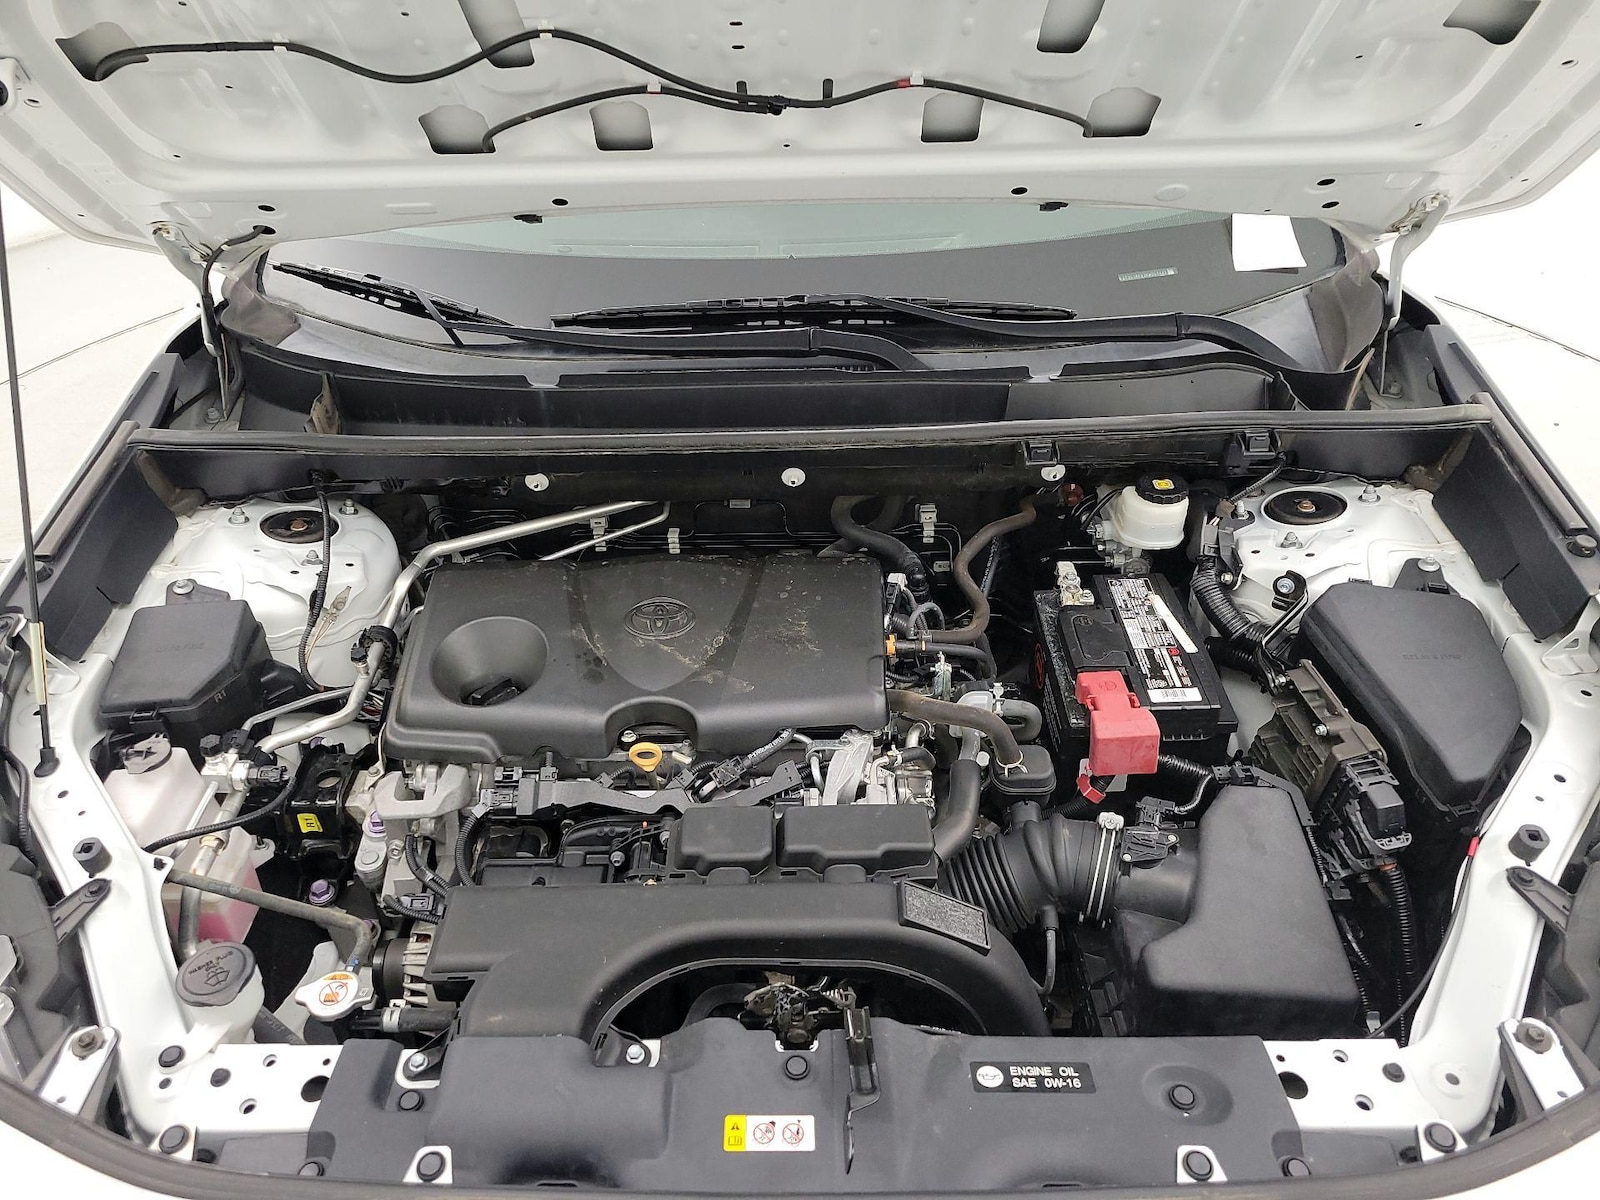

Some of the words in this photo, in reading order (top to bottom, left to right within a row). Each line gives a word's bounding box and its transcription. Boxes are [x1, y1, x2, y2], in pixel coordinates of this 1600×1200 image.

[1009, 1066, 1053, 1077] ENGINE
[1058, 1066, 1080, 1077] OIL
[1012, 1077, 1038, 1088] SAE
[1044, 1078, 1082, 1089] 0W-16
